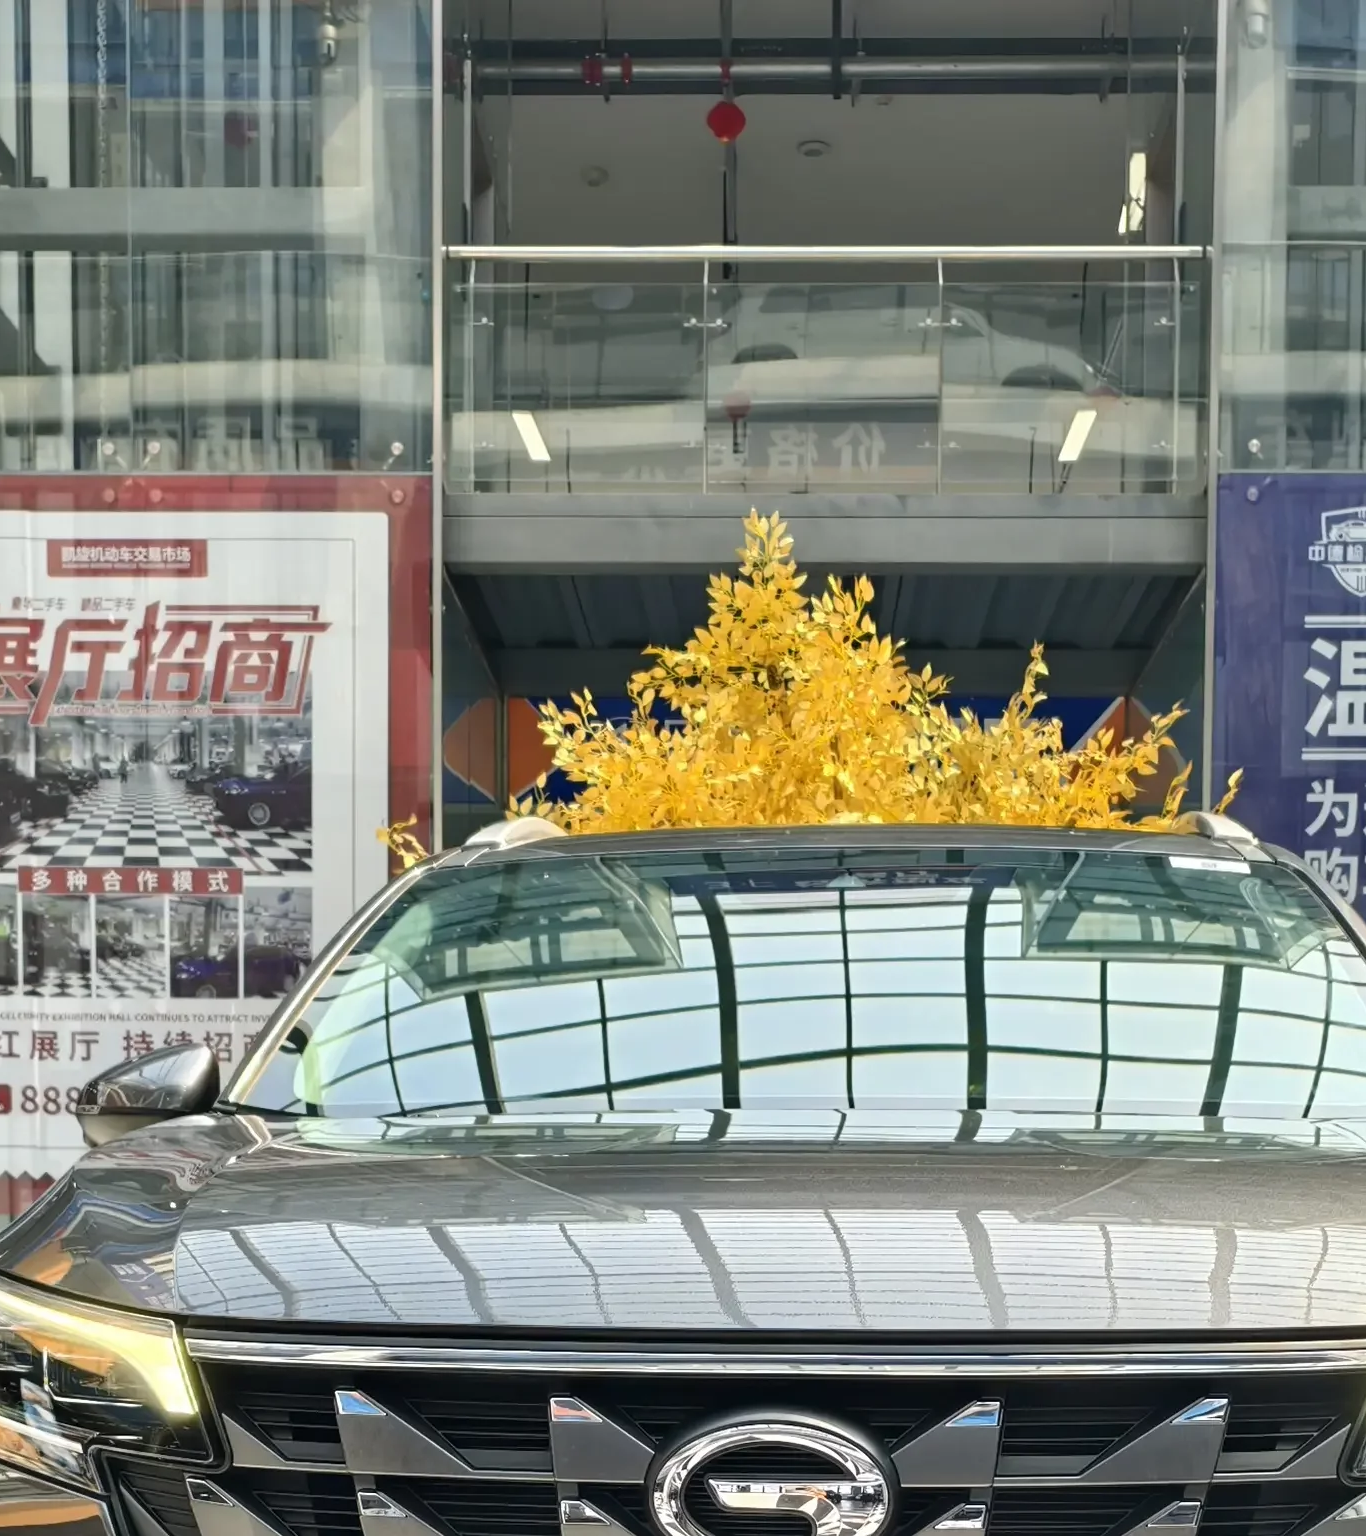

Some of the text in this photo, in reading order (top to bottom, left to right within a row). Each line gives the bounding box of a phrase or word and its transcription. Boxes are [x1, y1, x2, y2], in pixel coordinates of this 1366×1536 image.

[61, 546, 191, 562] 凯旋机动车交易市场
[30, 869, 231, 893] 多种合作模式
[134, 1012, 190, 1023] CONTINUES
[192, 1013, 205, 1022] TO
[207, 1013, 249, 1023] ATTRACT
